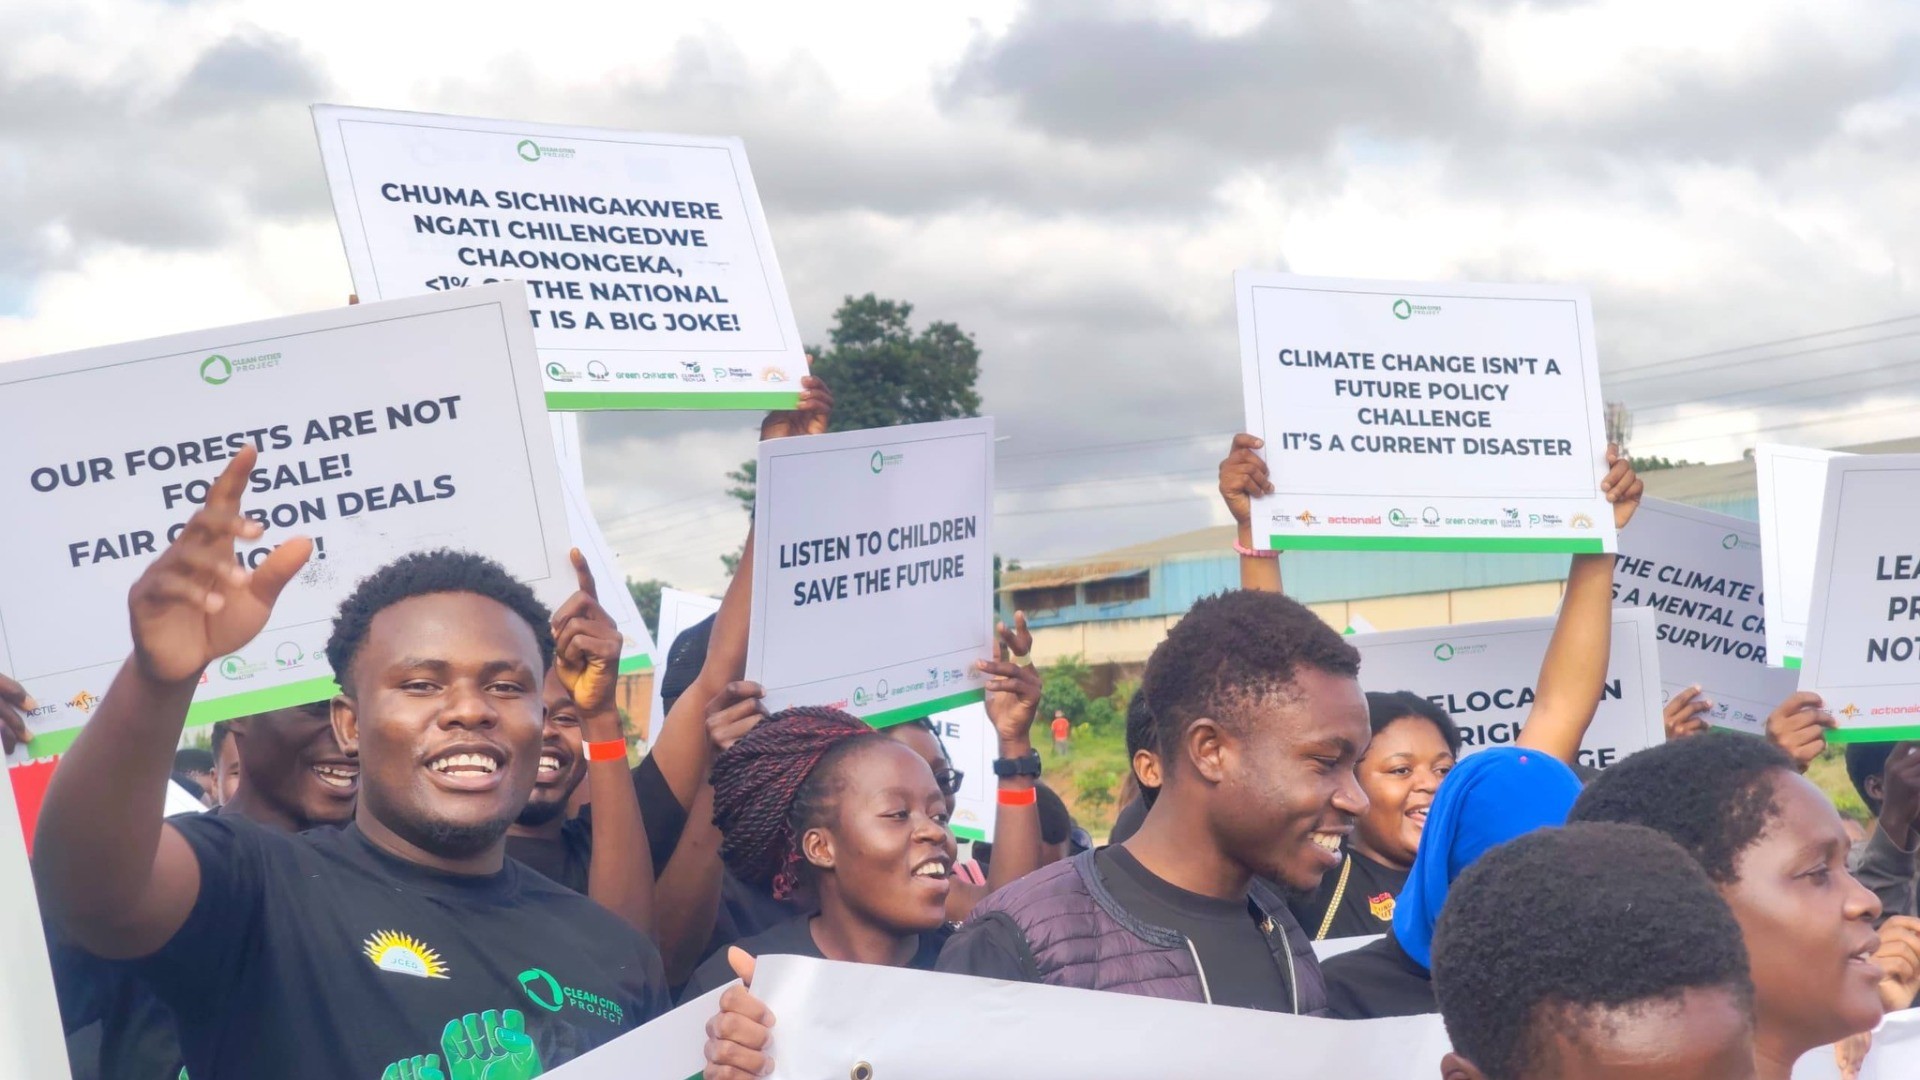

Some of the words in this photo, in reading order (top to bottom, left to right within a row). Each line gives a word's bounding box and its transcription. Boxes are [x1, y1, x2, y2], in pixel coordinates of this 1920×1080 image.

[381, 183, 489, 208] CHUMA
[495, 190, 723, 220] SICHINGAKWERE
[414, 214, 500, 238] NGATI
[508, 221, 708, 247] CHILENGEDWE
[458, 247, 683, 277] CHAONONGEKA,
[527, 280, 584, 300] THE
[591, 283, 728, 304] NATIONAL
[549, 310, 576, 330] IS
[585, 312, 604, 330] A
[611, 312, 655, 332] BIG
[664, 313, 741, 332] JOKE!
[236, 360, 279, 372] PROJECT
[1279, 349, 1375, 371] CLIMATE
[1382, 353, 1476, 374] CHANGE
[1483, 356, 1538, 375] ISN'T
[1545, 359, 1561, 375] A
[1335, 380, 1421, 399] FUTURE
[1429, 382, 1509, 401] POLICY
[1357, 407, 1491, 428] CHALLENGE
[30, 455, 113, 493] OUR
[126, 424, 292, 477] FORESTS
[303, 409, 377, 445] ARE
[386, 395, 462, 430] NOT
[1282, 432, 1322, 451] IT'S
[1329, 434, 1345, 451] A
[1350, 435, 1456, 455] CURRENT
[1463, 438, 1572, 456] DISASTER
[162, 476, 222, 509] FO
[249, 453, 352, 493] SALE!
[68, 530, 156, 568] FAIR
[167, 498, 327, 545] CBON
[337, 474, 456, 516] DEALS
[780, 536, 850, 569] LISTEN
[856, 531, 882, 556] TO
[887, 516, 976, 551] CHILDREN
[793, 575, 848, 606] SAVE
[854, 568, 890, 596] THE
[897, 555, 964, 589] FUTURE
[1614, 554, 1655, 579] THE
[1658, 565, 1755, 602] CLIMATE
[1623, 588, 1640, 606] A
[1647, 592, 1734, 627] MENTAL
[1656, 624, 1767, 665] SURVIVOR
[26, 704, 58, 717] ACTIE
[563, 986, 597, 1006] CLEAN
[599, 998, 624, 1018] CITIES
[570, 999, 623, 1025] PROJECT
